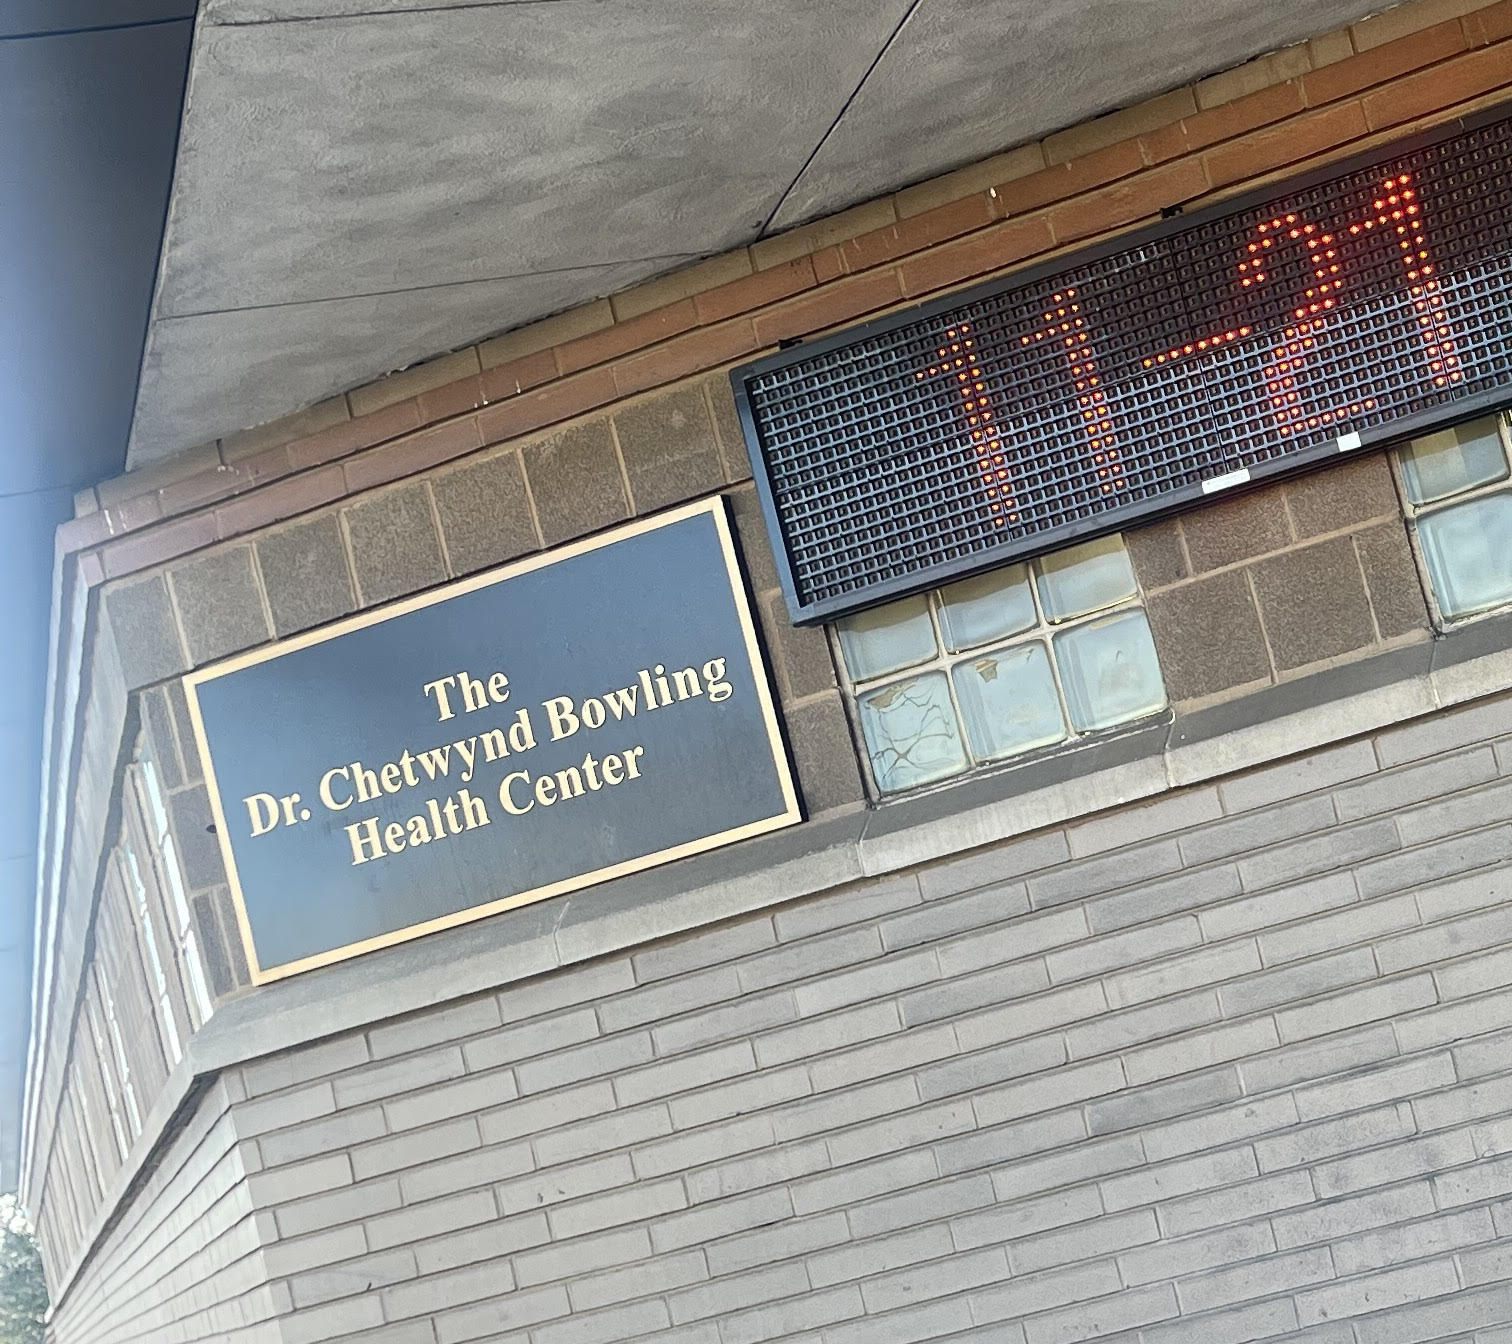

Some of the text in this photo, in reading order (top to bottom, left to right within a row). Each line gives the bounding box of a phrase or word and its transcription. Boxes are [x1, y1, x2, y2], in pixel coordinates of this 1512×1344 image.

[243, 657, 734, 838] Dr. Chetwynd Bowling
[423, 669, 511, 723] The
[344, 742, 645, 867] Health Center
